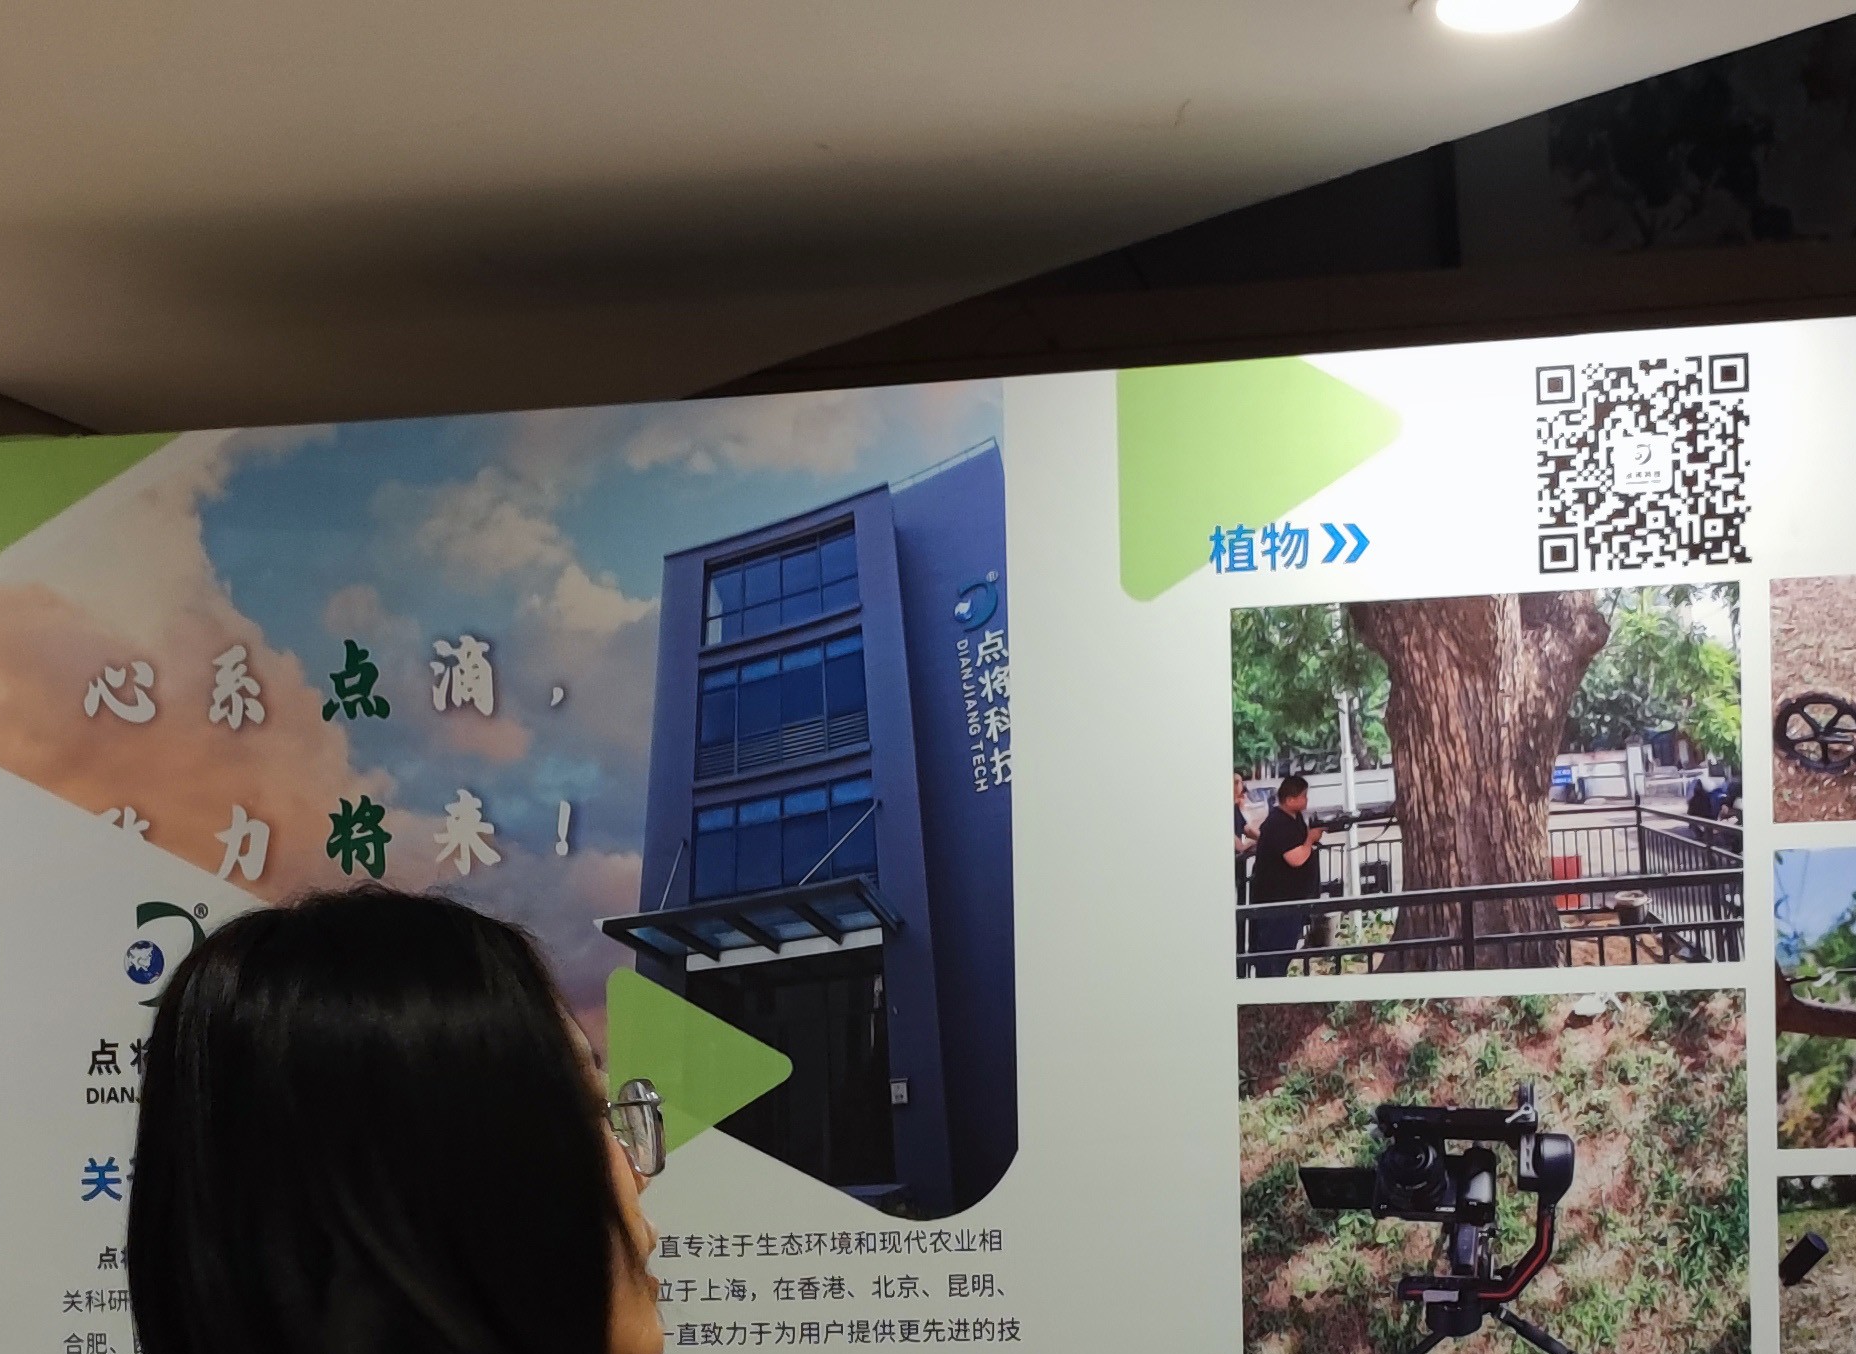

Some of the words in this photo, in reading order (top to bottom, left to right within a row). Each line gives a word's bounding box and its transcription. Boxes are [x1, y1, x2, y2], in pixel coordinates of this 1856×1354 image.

[1208, 523, 1311, 574] 植物
[956, 638, 982, 737] DIANJIANG
[970, 739, 989, 793] TECH
[86, 1086, 142, 1105] DIAN
[81, 1157, 136, 1201] 关
[658, 1228, 1003, 1258] 直专注于生态环境和现代农业相
[63, 1289, 131, 1313] 关科研
